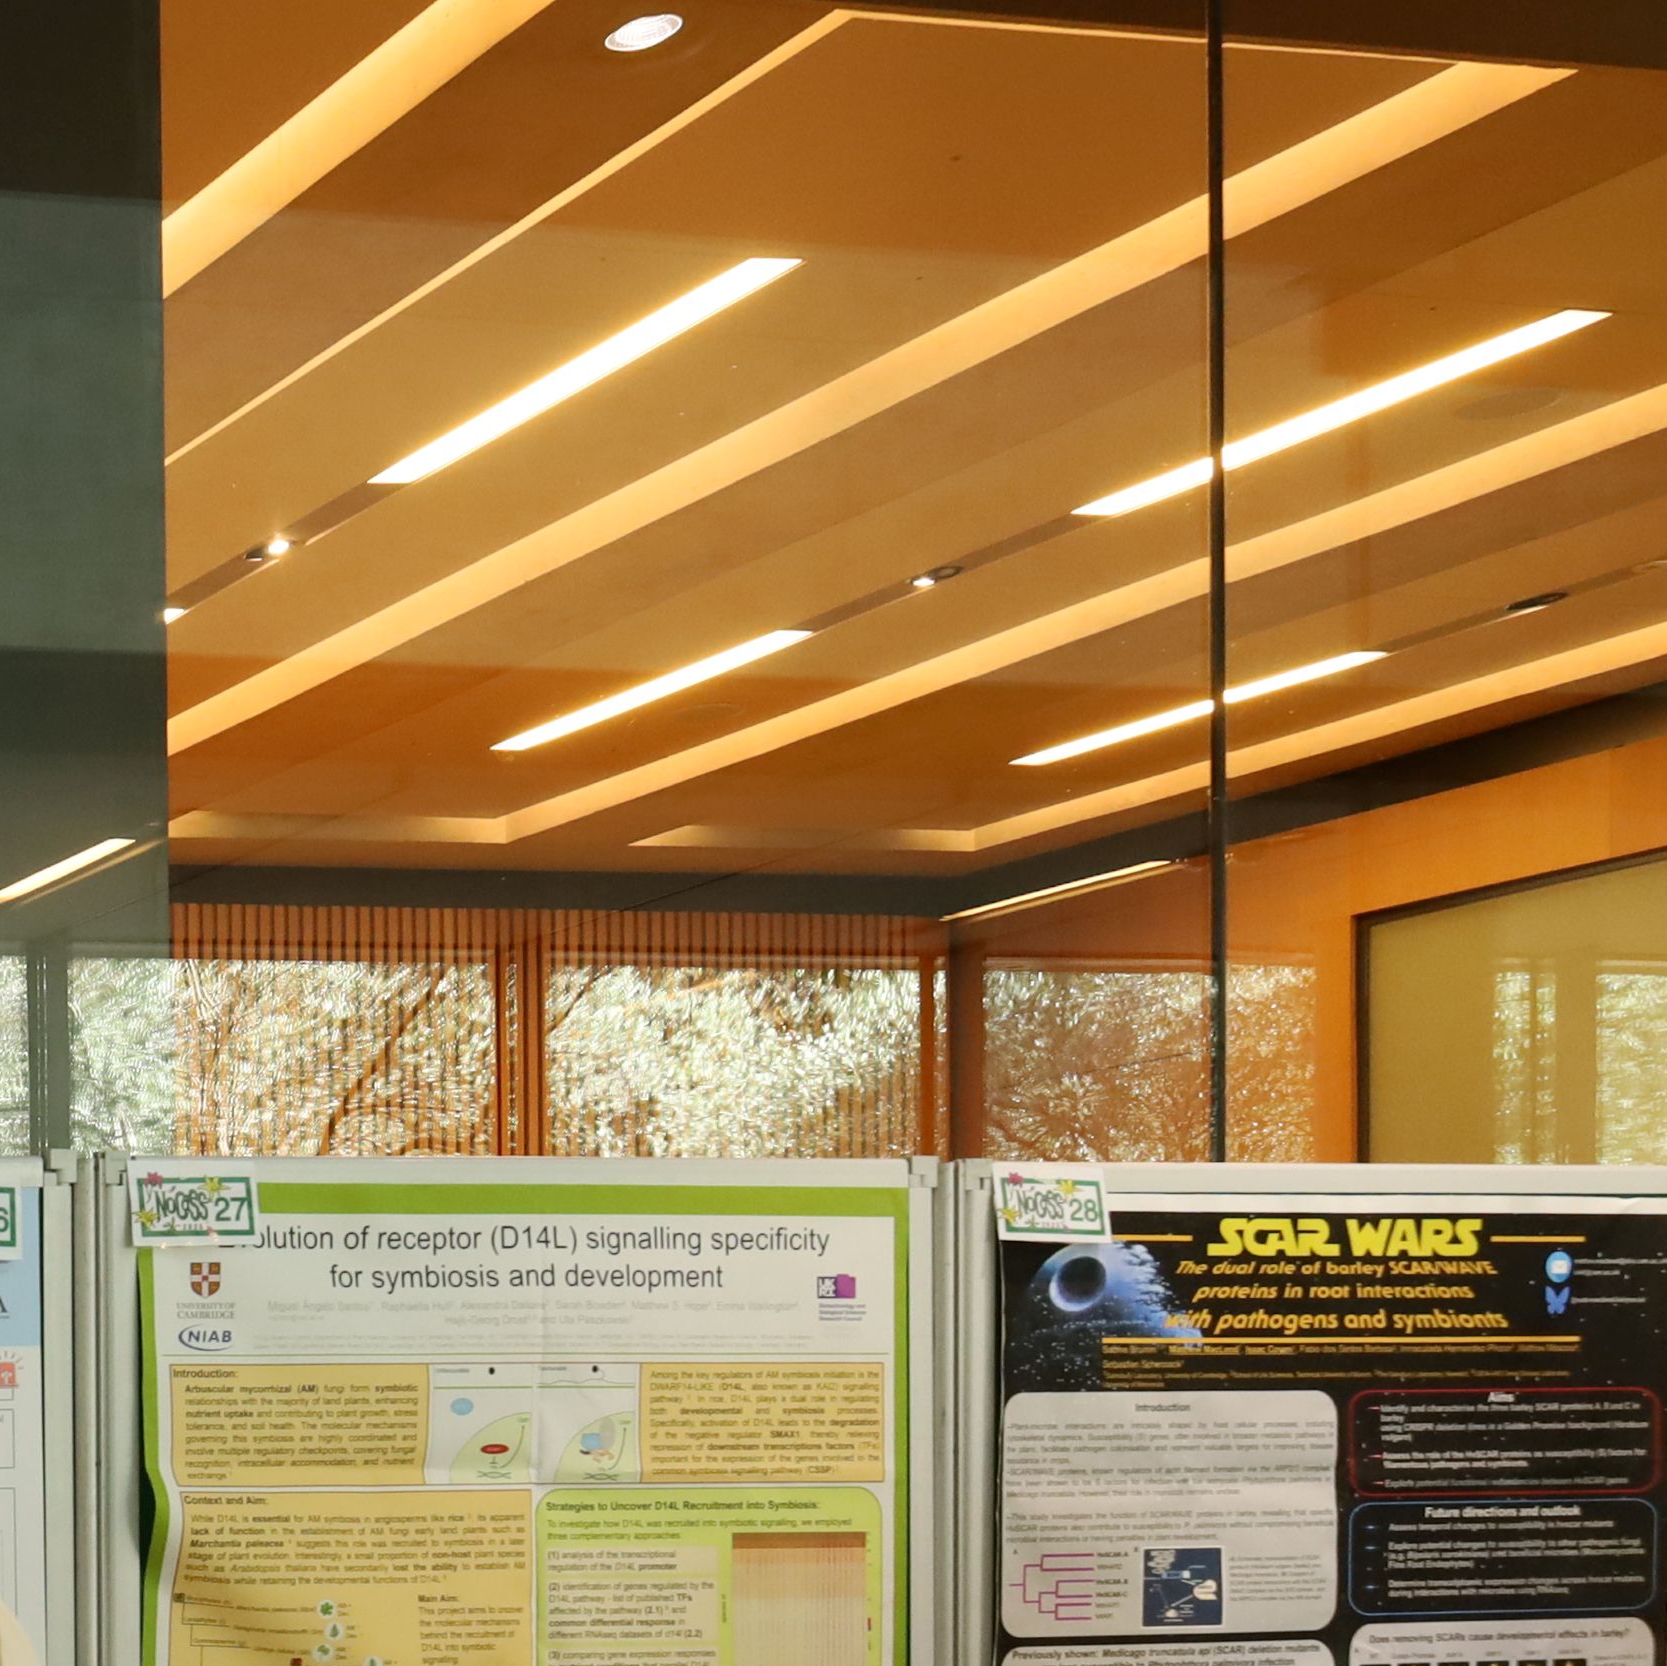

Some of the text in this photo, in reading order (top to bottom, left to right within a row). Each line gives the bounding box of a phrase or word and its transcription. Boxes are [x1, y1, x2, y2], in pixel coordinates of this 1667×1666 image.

[214, 1197, 248, 1222] 27
[1069, 1198, 1098, 1222] 28
[343, 1224, 371, 1251] of
[377, 1226, 482, 1257] receptor
[490, 1224, 578, 1256] (D14L)
[585, 1224, 702, 1258] signalling
[710, 1225, 830, 1258] specificity
[1207, 1218, 1482, 1257] SCAR WARS
[329, 1262, 723, 1294] for symbiosis and development
[1175, 1259, 1498, 1279] The dual role of barley SCAR/WAVE
[1191, 1281, 1475, 1304] proteins in root interactions
[176, 1310, 236, 1320] CAMBRIDGE
[1164, 1307, 1509, 1336] with pathogens and symbionts
[187, 1329, 233, 1343] NIAB
[172, 1368, 238, 1381] Introduction:
[1134, 1402, 1191, 1413] Introduction
